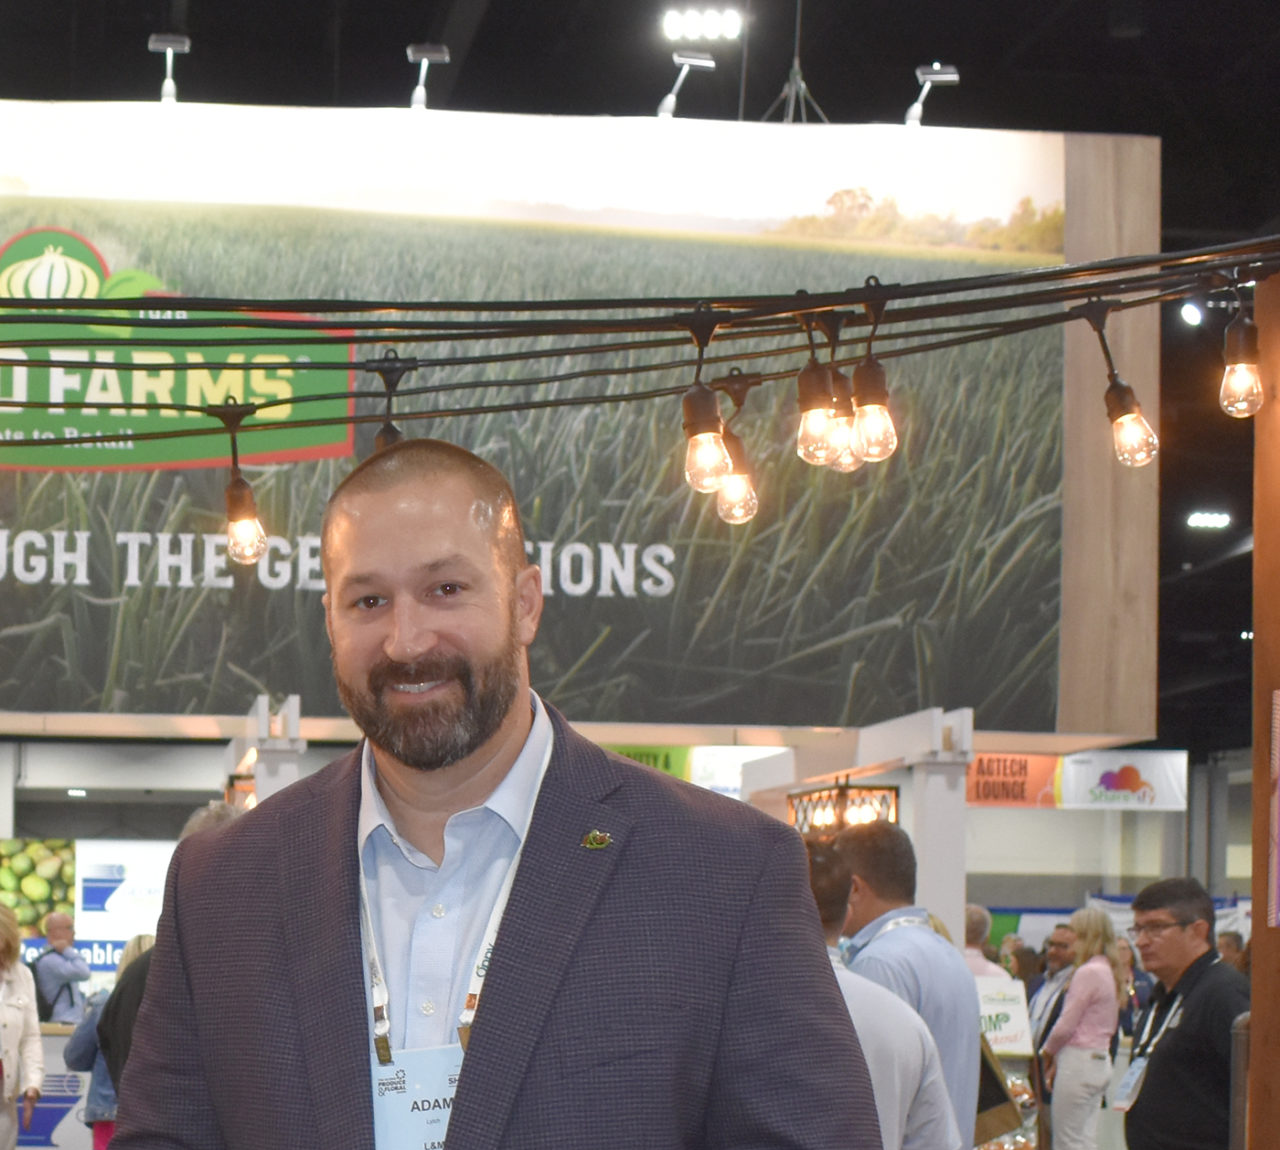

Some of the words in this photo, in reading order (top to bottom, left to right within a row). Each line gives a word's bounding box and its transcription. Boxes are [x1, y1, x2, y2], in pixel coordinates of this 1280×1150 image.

[48, 349, 294, 420] FARMS
[116, 532, 234, 589] THE
[257, 535, 676, 598] GEIONS
[976, 757, 1028, 777] AGTECH
[976, 779, 1028, 800] LOUNGE
